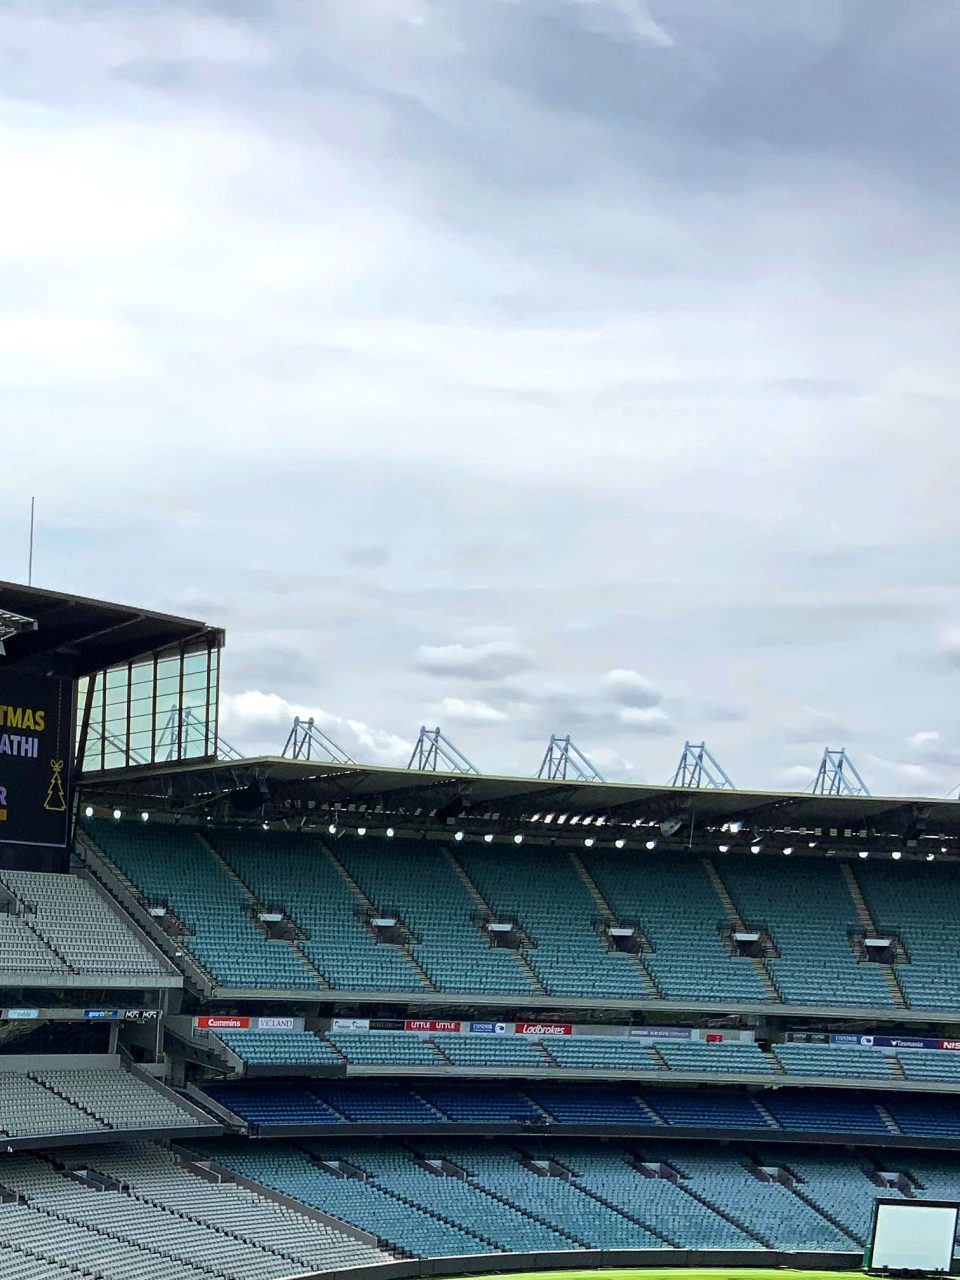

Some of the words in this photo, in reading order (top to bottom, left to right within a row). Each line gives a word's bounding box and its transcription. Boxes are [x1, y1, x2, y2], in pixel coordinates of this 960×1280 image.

[208, 1019, 241, 1027] Cummins
[411, 1021, 430, 1029] LITTLE
[522, 1024, 565, 1035] Ladbrokes
